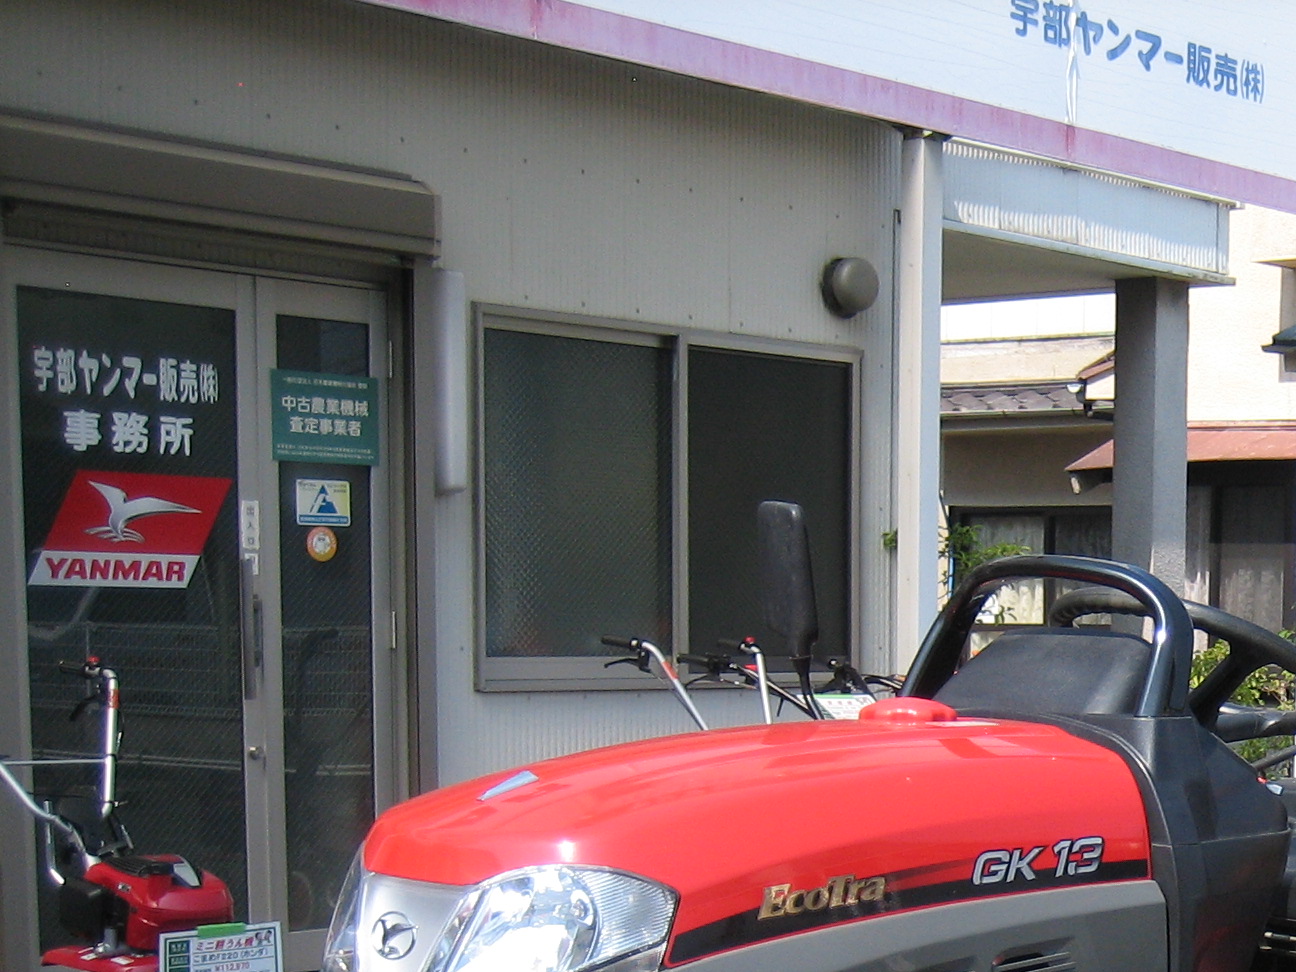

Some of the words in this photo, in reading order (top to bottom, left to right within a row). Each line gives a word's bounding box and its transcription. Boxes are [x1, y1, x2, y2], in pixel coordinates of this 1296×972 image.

[281, 395, 369, 418] 中古農業機械
[63, 409, 194, 457] 事務所
[290, 416, 361, 437] 査定事業者
[45, 557, 186, 582] YANMAR
[971, 846, 1043, 886] GK
[1054, 836, 1104, 877] 13
[757, 874, 887, 920] EcoTra
